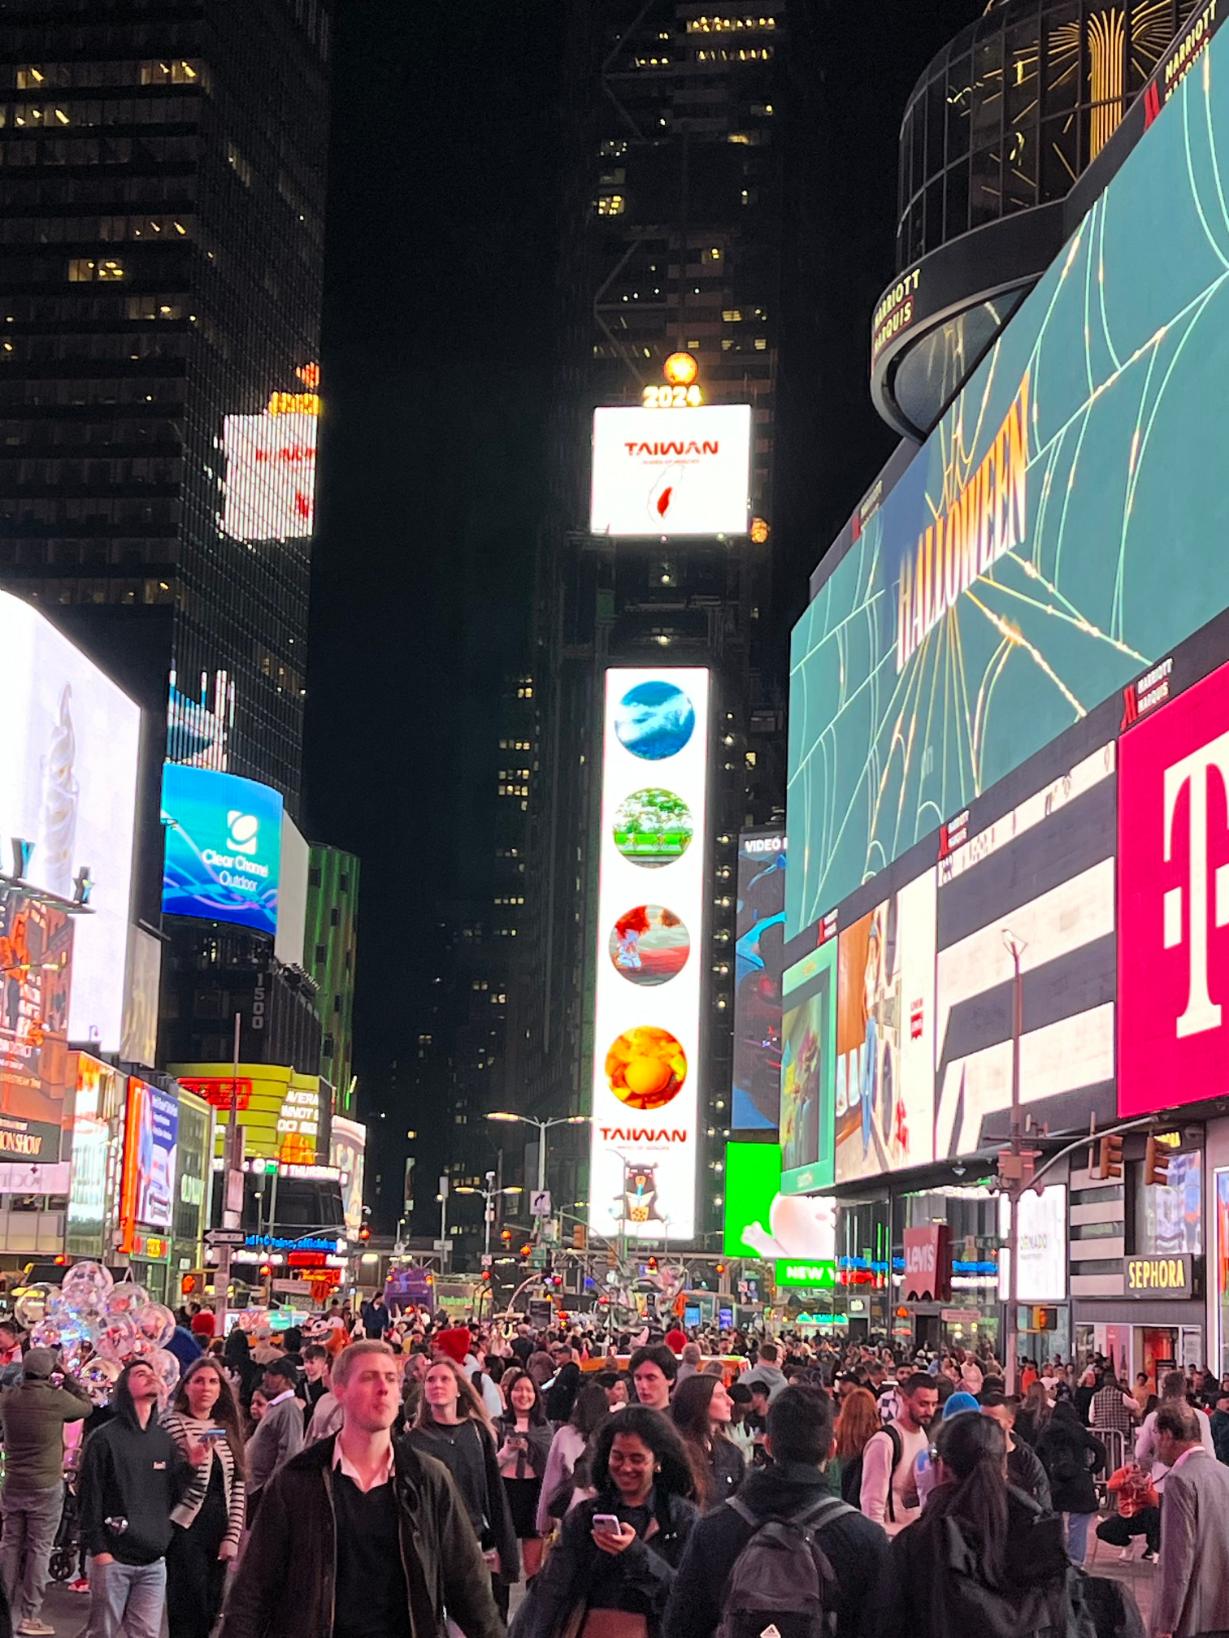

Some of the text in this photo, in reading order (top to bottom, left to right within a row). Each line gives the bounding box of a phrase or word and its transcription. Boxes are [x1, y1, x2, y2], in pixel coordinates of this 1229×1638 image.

[642, 385, 704, 408] 2024
[624, 440, 719, 456] TAIWAN
[896, 368, 1030, 675] HALLOWEEN
[745, 839, 781, 853] VIDEO
[201, 848, 235, 868] Clear
[219, 869, 258, 892] Outdoor
[251, 972, 266, 1030] 1500
[599, 1127, 687, 1142] TAIWAN
[786, 1265, 824, 1280] NEW
[1128, 1258, 1186, 1290] SEPHORA
